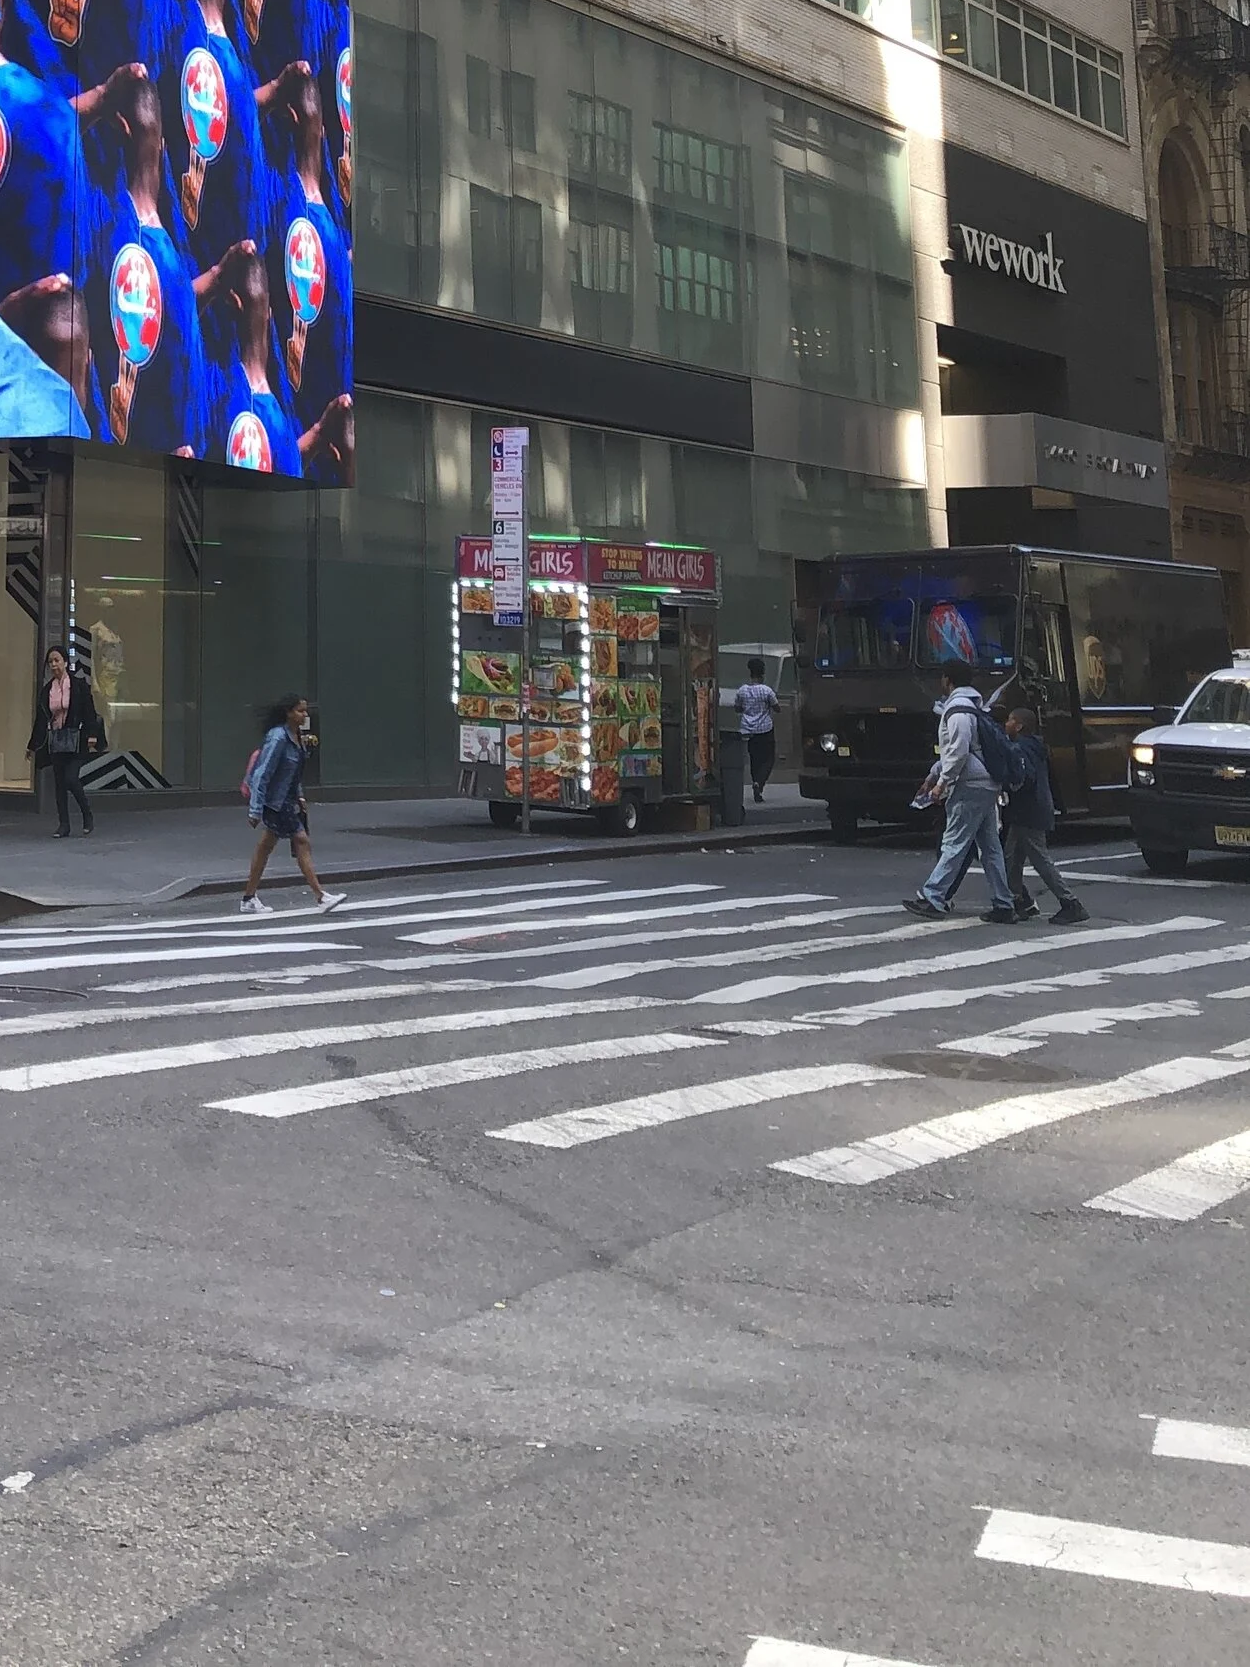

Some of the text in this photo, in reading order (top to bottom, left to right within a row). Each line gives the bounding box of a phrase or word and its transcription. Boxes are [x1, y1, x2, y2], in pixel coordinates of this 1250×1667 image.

[959, 223, 1068, 295] wework
[495, 460, 502, 472] 3
[495, 521, 503, 534] 6
[601, 547, 618, 559] STOP
[528, 550, 575, 576] GIRLS
[607, 558, 638, 571] TO MAKE
[646, 551, 705, 582] MEAN GIRLS
